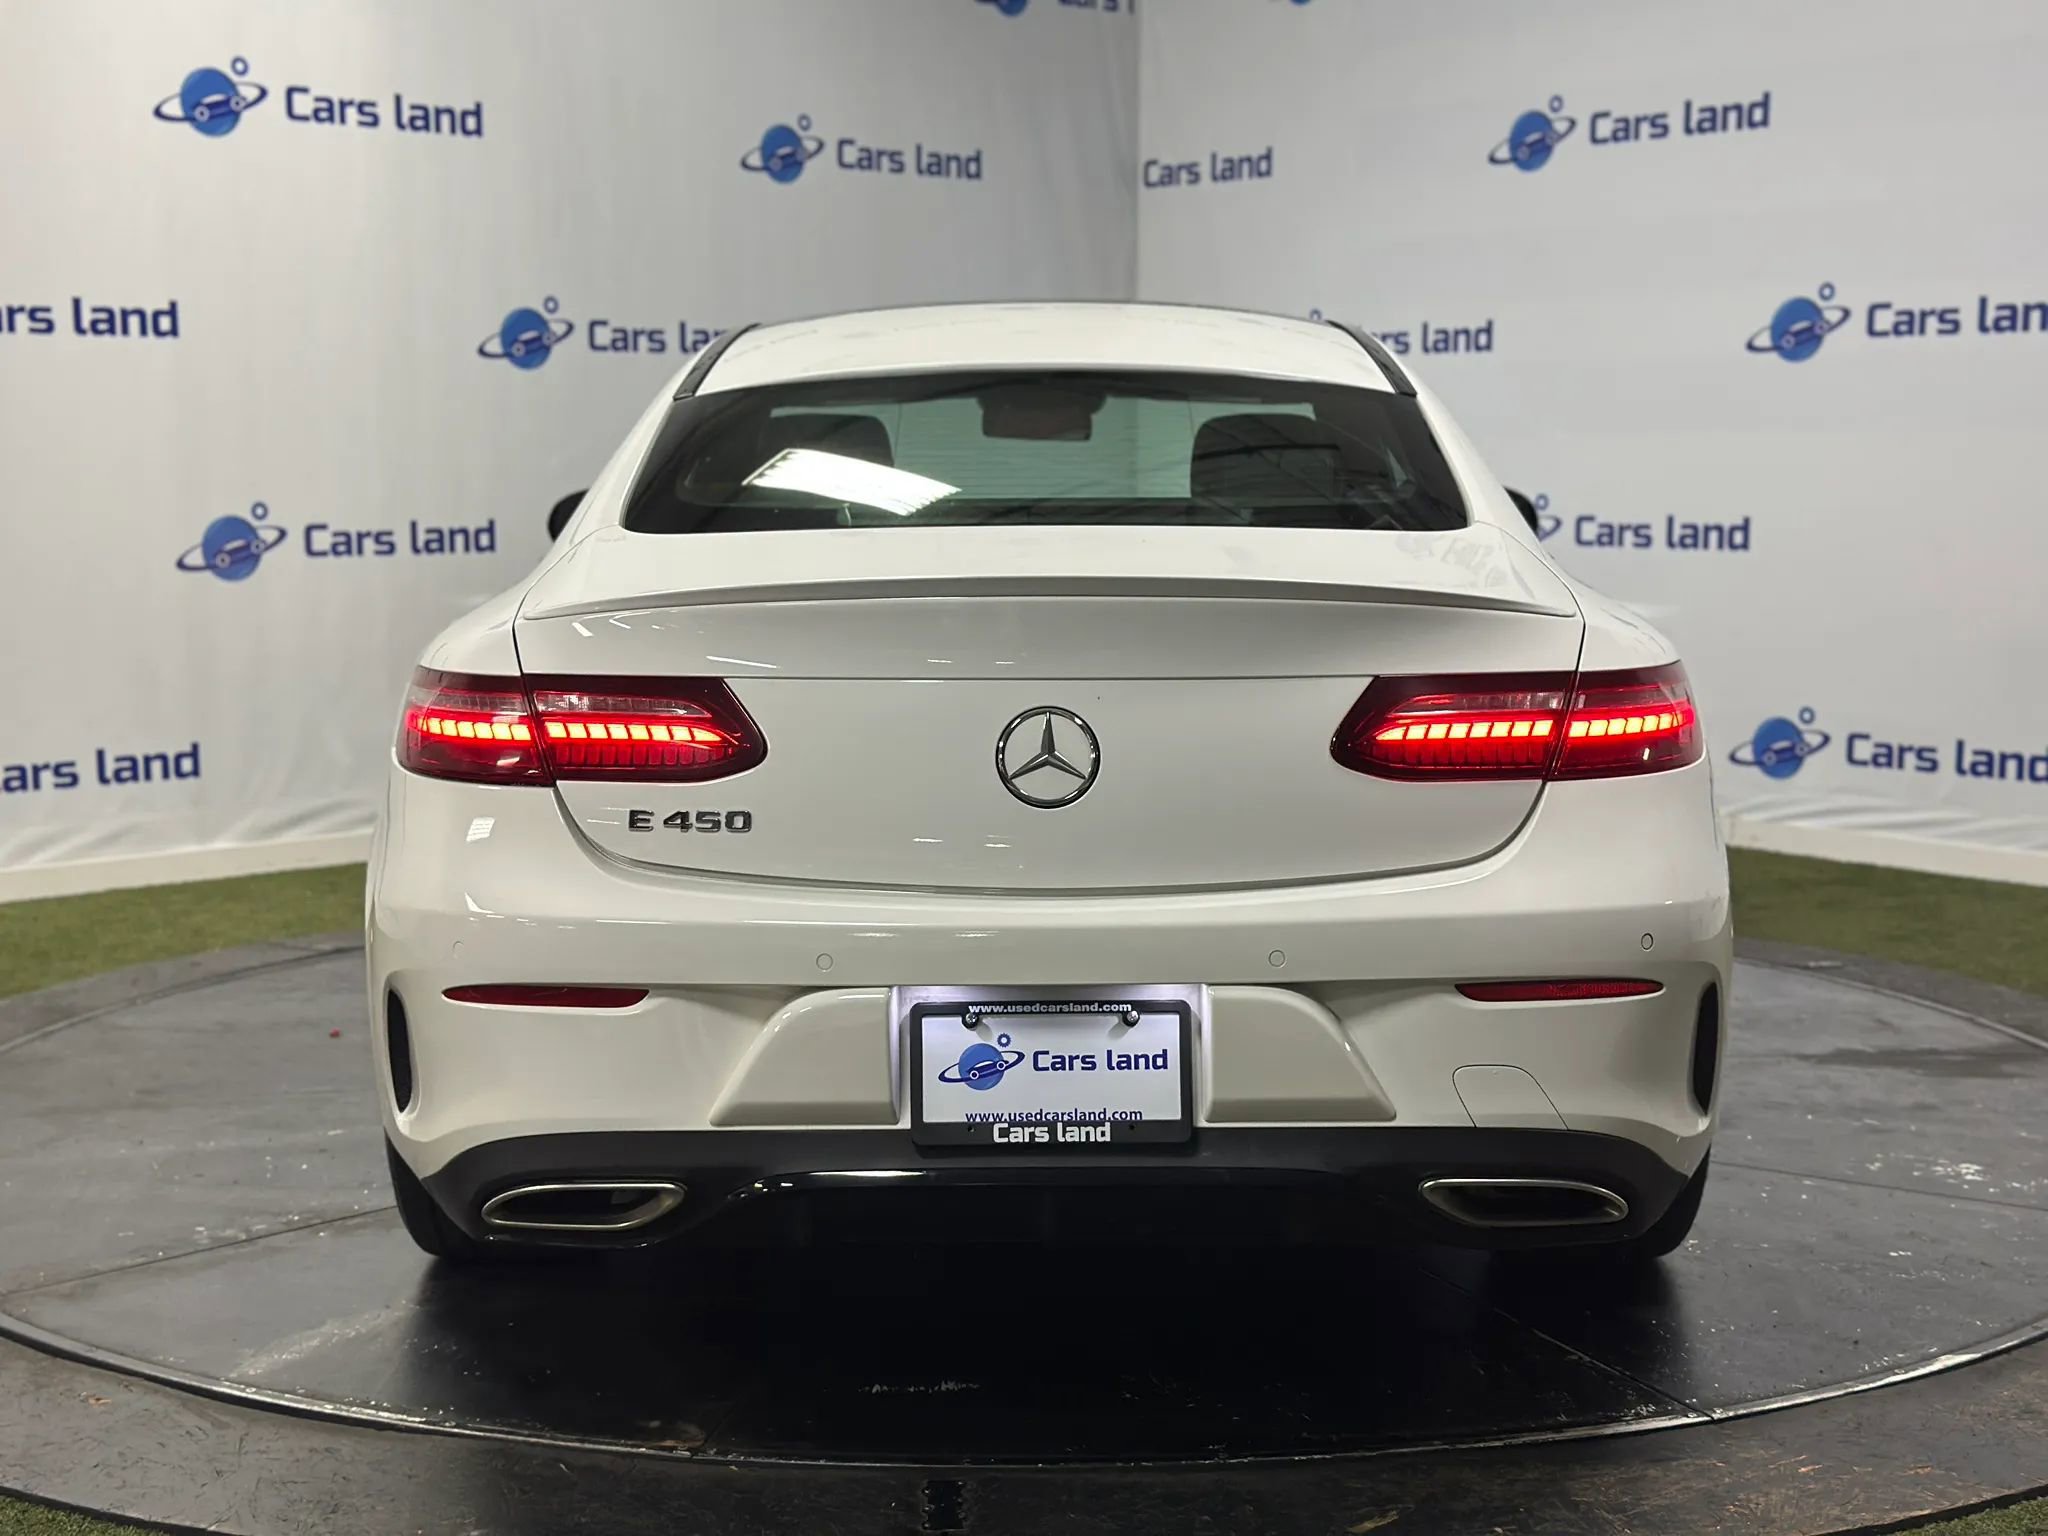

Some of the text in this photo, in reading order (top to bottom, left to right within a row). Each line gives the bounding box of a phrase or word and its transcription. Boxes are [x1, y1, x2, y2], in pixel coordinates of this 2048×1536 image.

[284, 85, 484, 138] Cars land
[1589, 91, 1772, 146] Cars land
[836, 138, 983, 181] Cars land
[1142, 146, 1273, 189] Cars land
[0, 297, 180, 338] rs land
[588, 319, 726, 354] Cars la
[1421, 318, 1495, 354] land
[1866, 295, 2048, 338] Cars lan
[304, 518, 497, 558] Cars land
[1574, 515, 1752, 552] Cars land
[0, 742, 201, 793] ars land
[1846, 732, 1940, 774] Cars
[628, 809, 753, 834] E 450
[967, 1002, 1133, 1014] www.usedcarsland.com
[1032, 1048, 1169, 1072] Cars land
[965, 1108, 1143, 1123] www.usedcarsland.com
[992, 1121, 1112, 1143] Cars land
